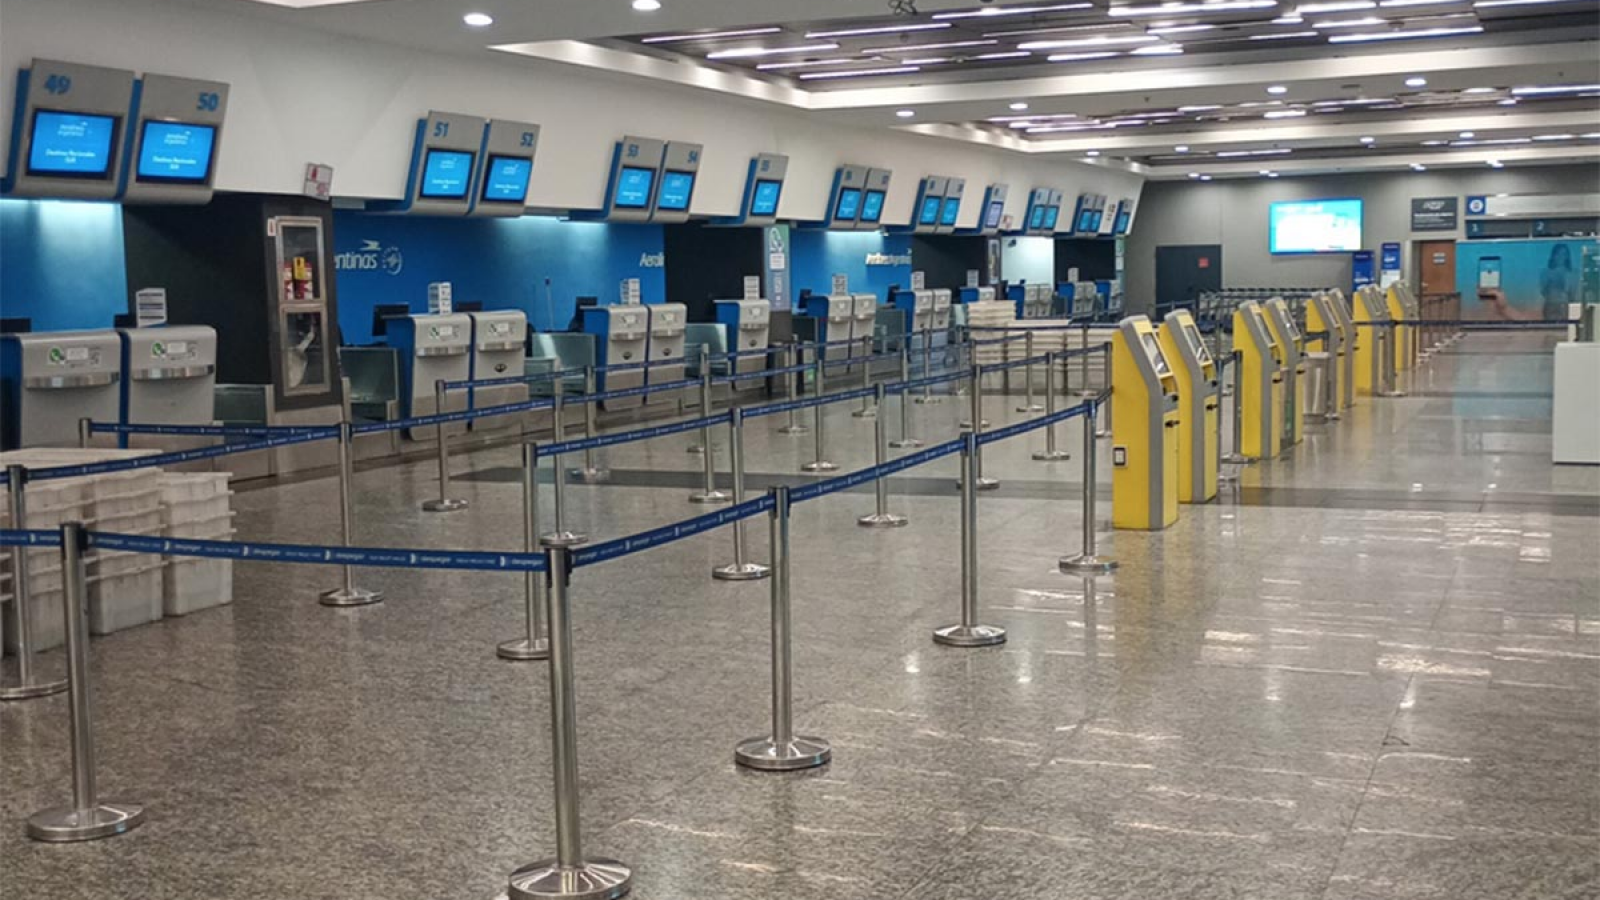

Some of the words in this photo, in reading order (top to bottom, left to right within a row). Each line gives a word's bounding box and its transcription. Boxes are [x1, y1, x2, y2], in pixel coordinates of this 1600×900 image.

[44, 74, 71, 95] 49
[196, 92, 220, 112] 50
[433, 121, 449, 138] 51
[520, 131, 534, 147] 52
